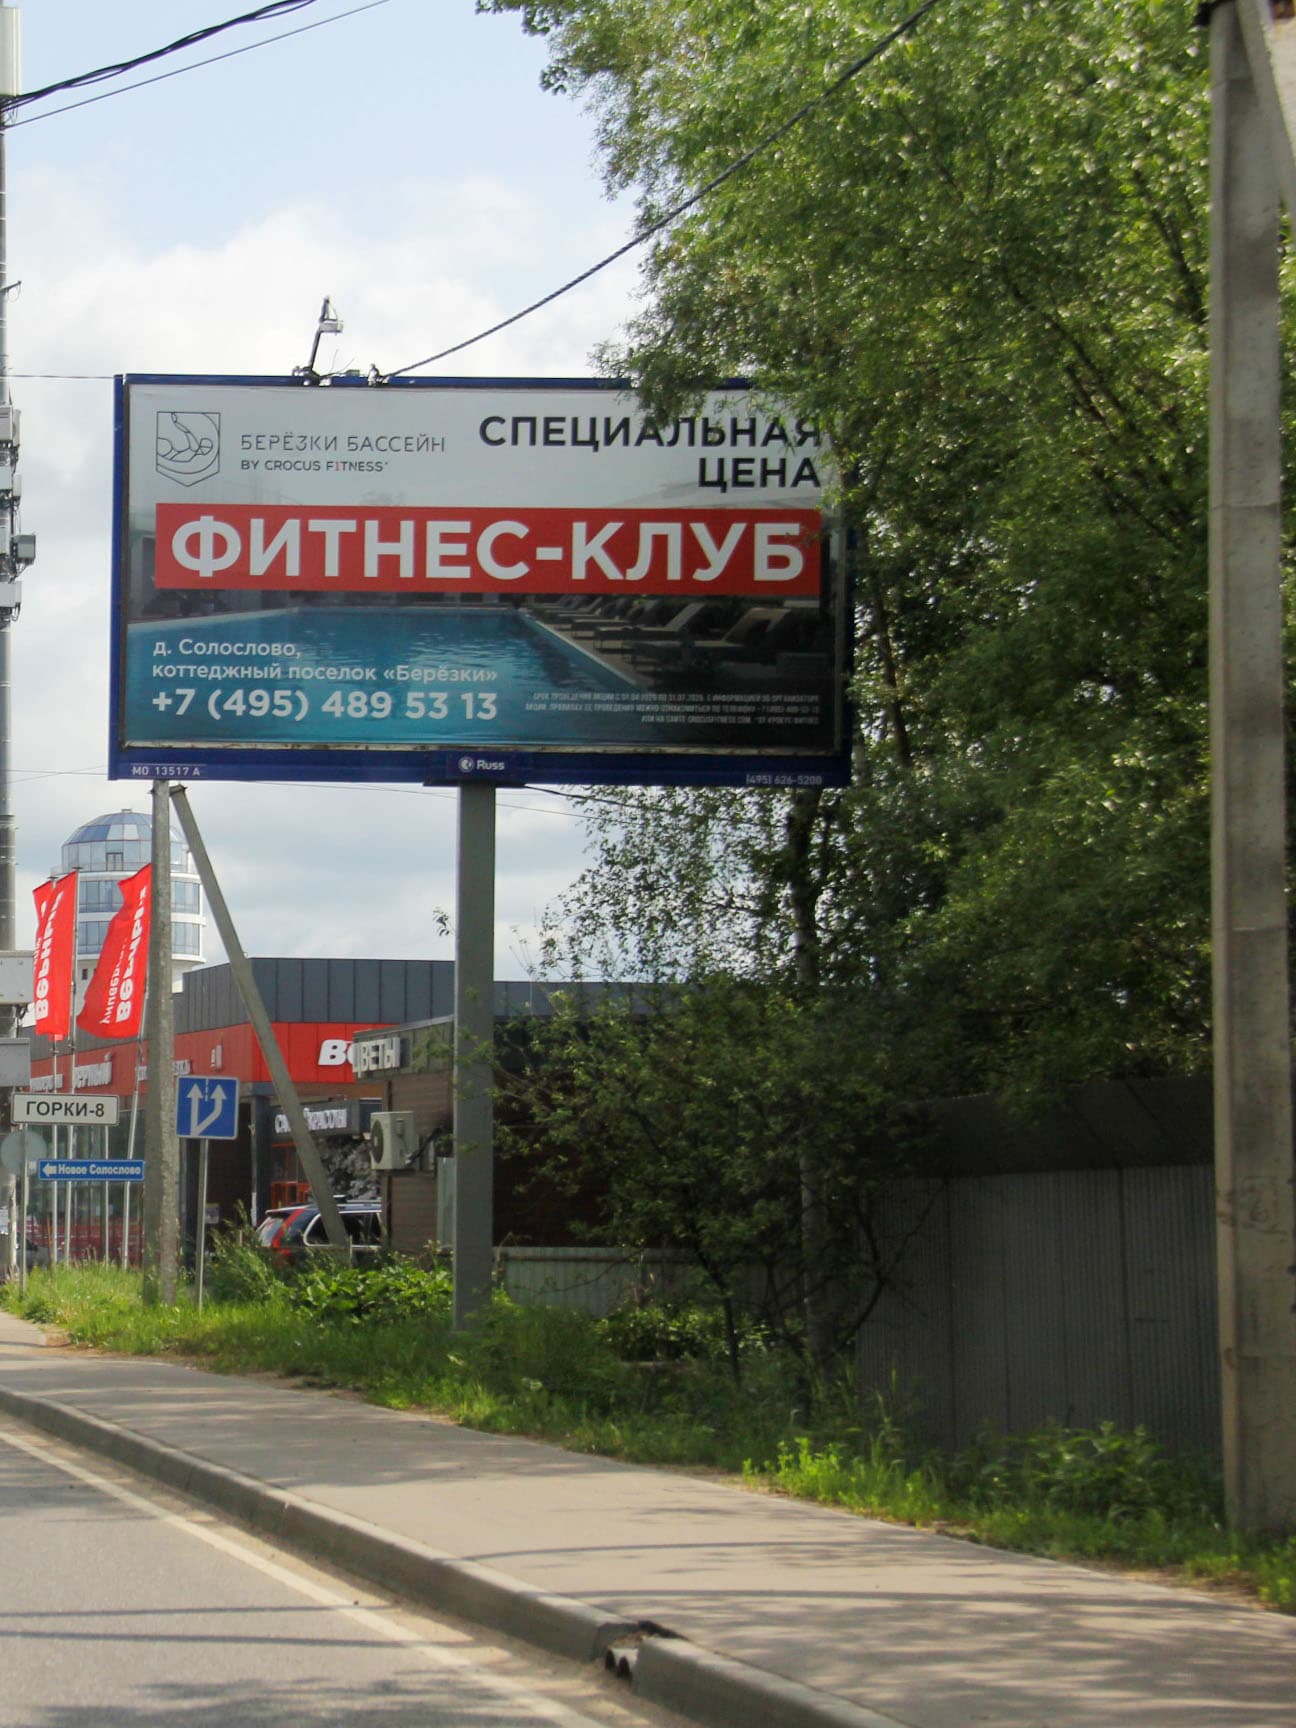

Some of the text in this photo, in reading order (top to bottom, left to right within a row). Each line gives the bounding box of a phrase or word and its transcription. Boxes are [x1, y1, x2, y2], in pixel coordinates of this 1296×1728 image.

[241, 432, 445, 453] БЕРЁЗКИ БАССЕЙН
[478, 415, 821, 453] СПЕЦИАЛЬНАЯ
[241, 460, 258, 471] BY
[265, 460, 321, 472] CROCUS
[698, 457, 821, 494] ЦЕНА
[171, 515, 804, 582] ФИТНЕС-КЛУБ
[153, 638, 302, 659] д. Солослово,
[152, 663, 282, 681] коттеджный
[288, 665, 377, 682] поселок
[152, 688, 497, 722] +7 (495) 489 53 13
[476, 759, 505, 770] Russ
[25, 1100, 105, 1118] ГОРКИ-8
[58, 1163, 141, 1175] Новое Солослово
